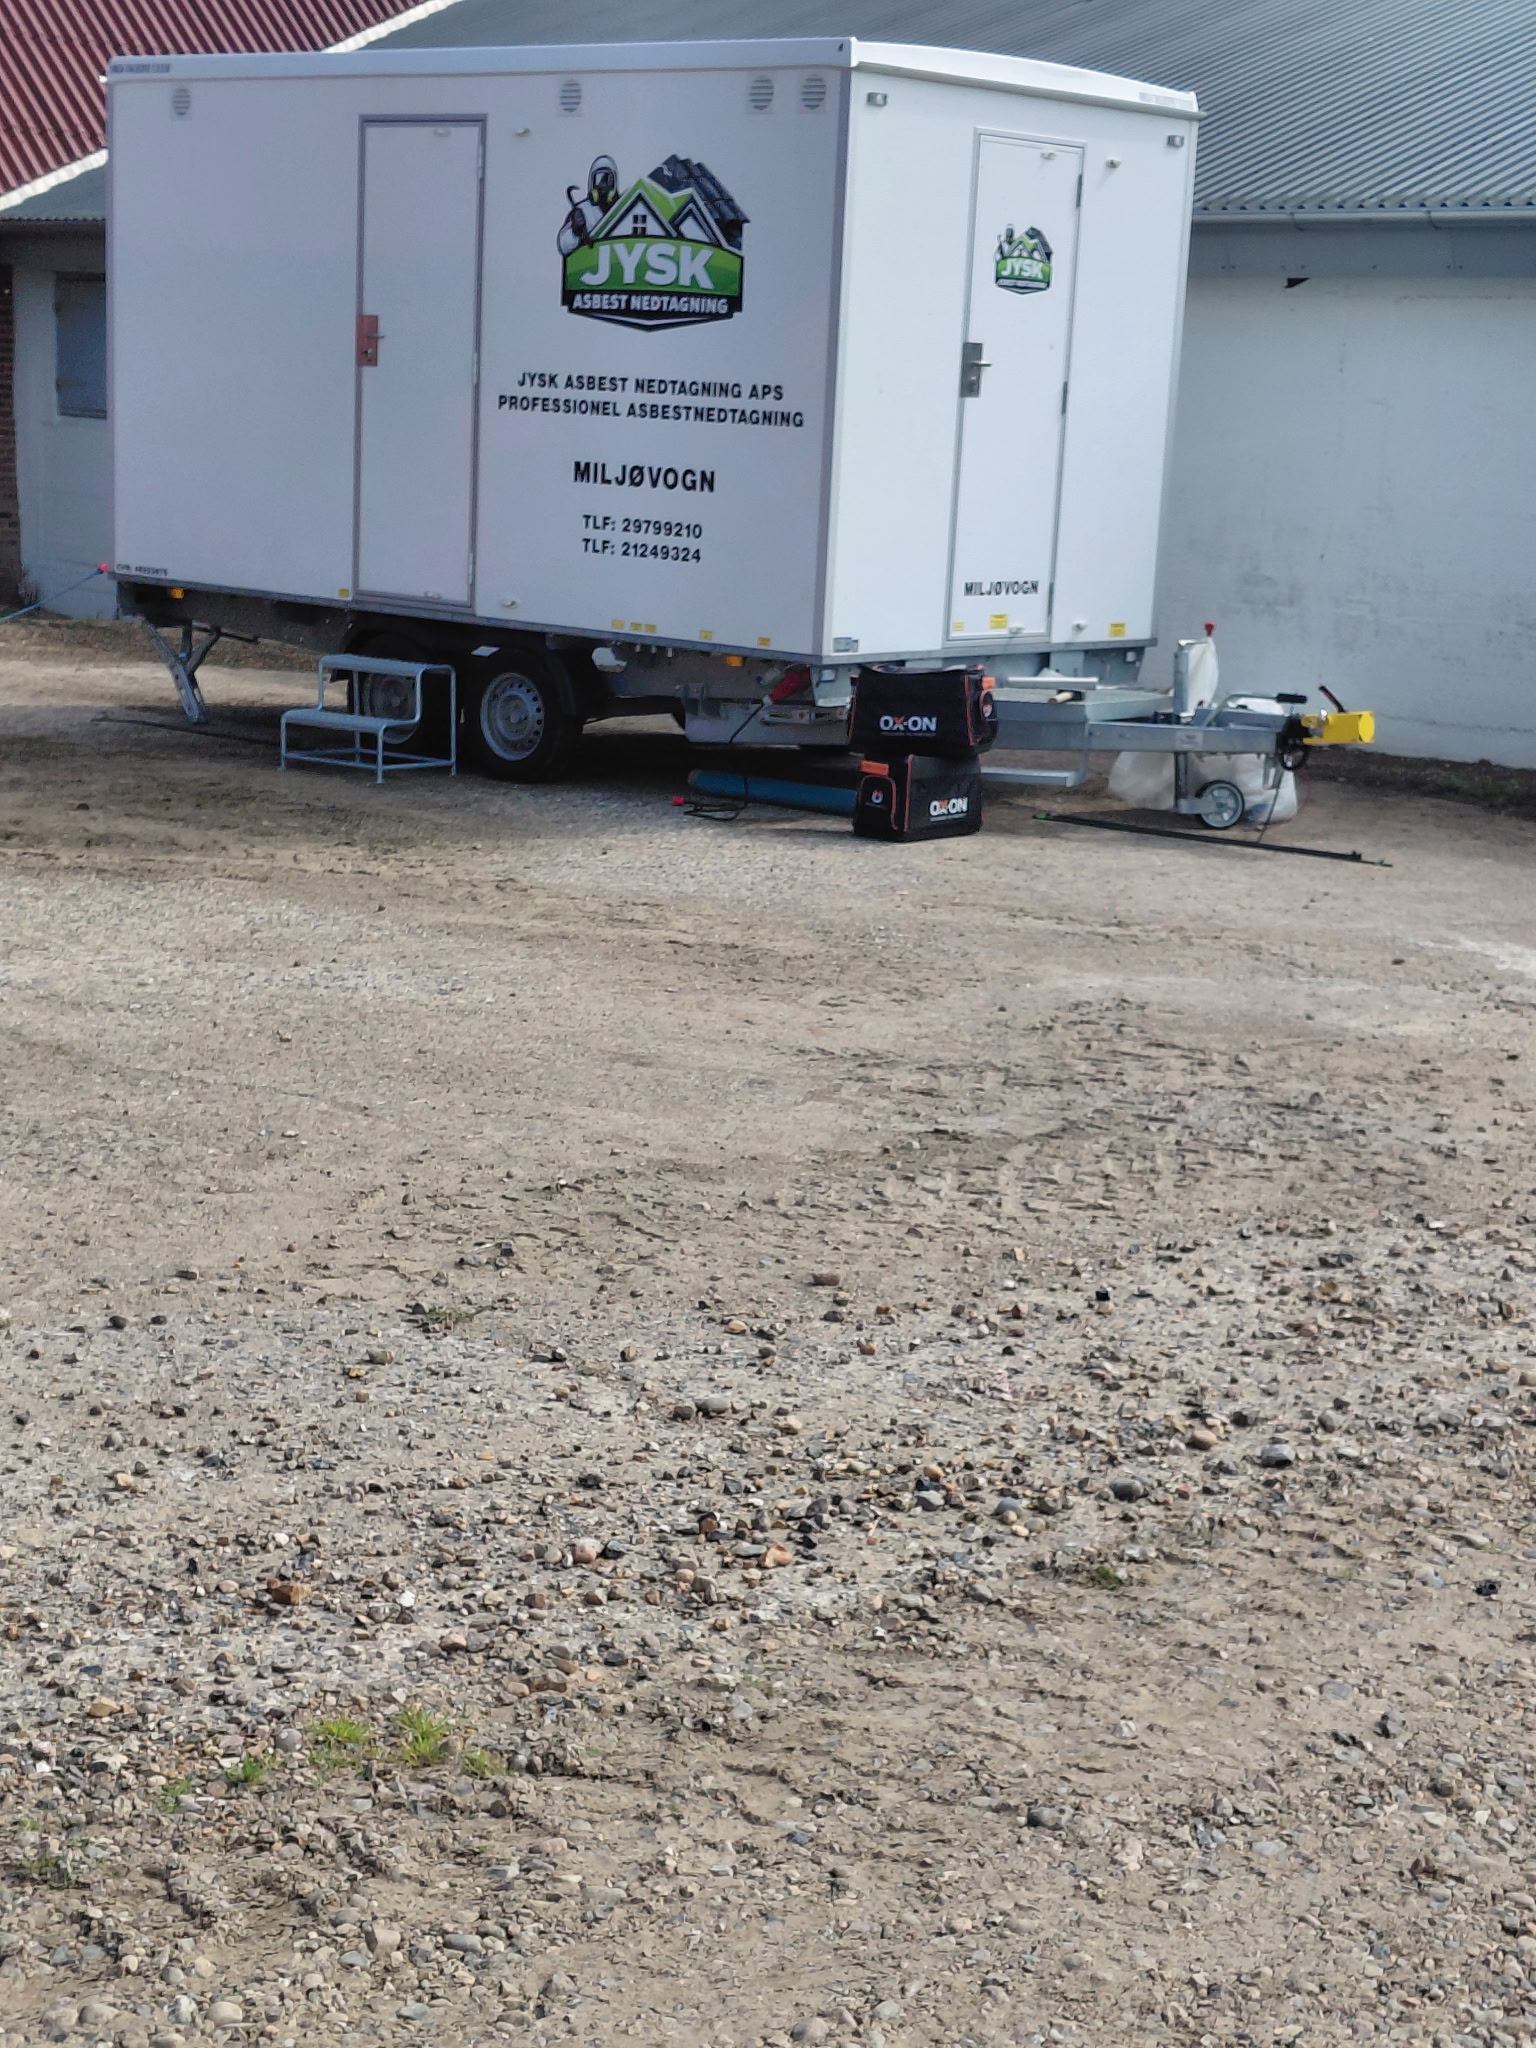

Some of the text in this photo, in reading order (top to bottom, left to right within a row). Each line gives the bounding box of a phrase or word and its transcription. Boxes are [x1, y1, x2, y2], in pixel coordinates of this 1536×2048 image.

[579, 242, 716, 290] JYSK
[1001, 258, 1043, 279] JYSK
[573, 293, 728, 314] ASBEST NEDTAGNING
[517, 372, 784, 401] JYSK ASBEST NEDTAGNING APS
[498, 395, 804, 428] PROFESSIONEL ASBESTNEDTAGNING
[573, 461, 716, 493] MILJØVOGN
[582, 514, 703, 539] TLF: 29799210
[582, 538, 701, 563] TLF: 21249324
[964, 581, 1039, 597] MILJØVOGN
[879, 715, 937, 732] OX-ON
[929, 796, 968, 816] OX-ON
